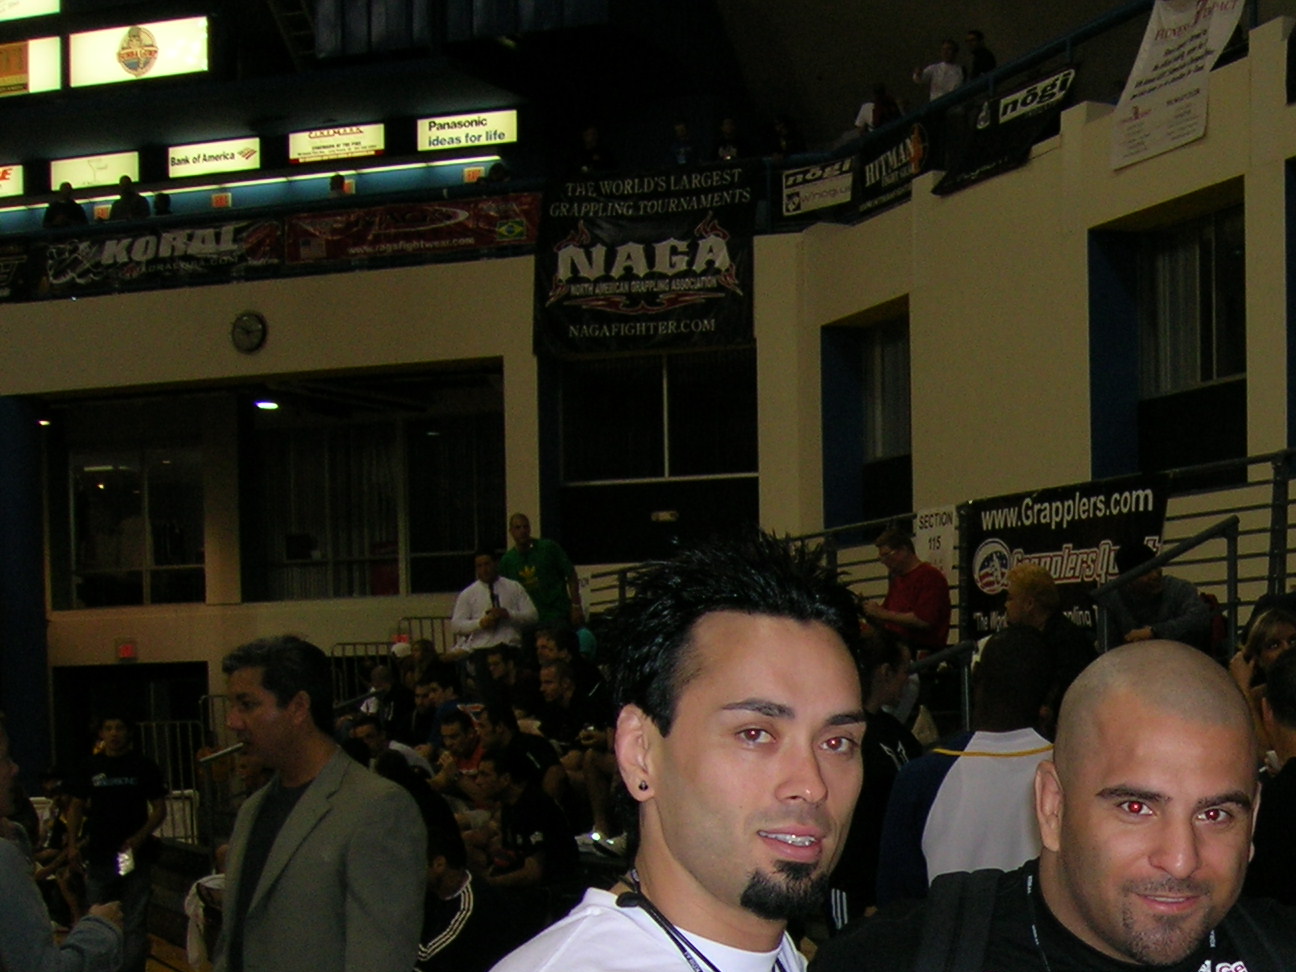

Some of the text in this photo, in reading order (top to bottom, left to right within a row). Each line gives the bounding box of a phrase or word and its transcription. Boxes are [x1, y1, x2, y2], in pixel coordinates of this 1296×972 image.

[428, 117, 488, 132] Panasonic
[428, 131, 506, 148] ideas for life
[170, 151, 236, 167] Bank of America
[565, 168, 742, 198] THE WORLD'S LARGEST
[550, 187, 751, 217] GRAPPLING TOURNAMENTS
[101, 224, 239, 265] KORAL
[556, 235, 732, 282] NAGA
[631, 278, 669, 294] GRAPPLING
[671, 275, 718, 292] ASSOCIATION
[568, 318, 716, 338] NAGAFIGHTER.COM
[981, 488, 1154, 531] www.Grapplers.com
[919, 510, 953, 530] SECTION
[928, 535, 942, 551] 115
